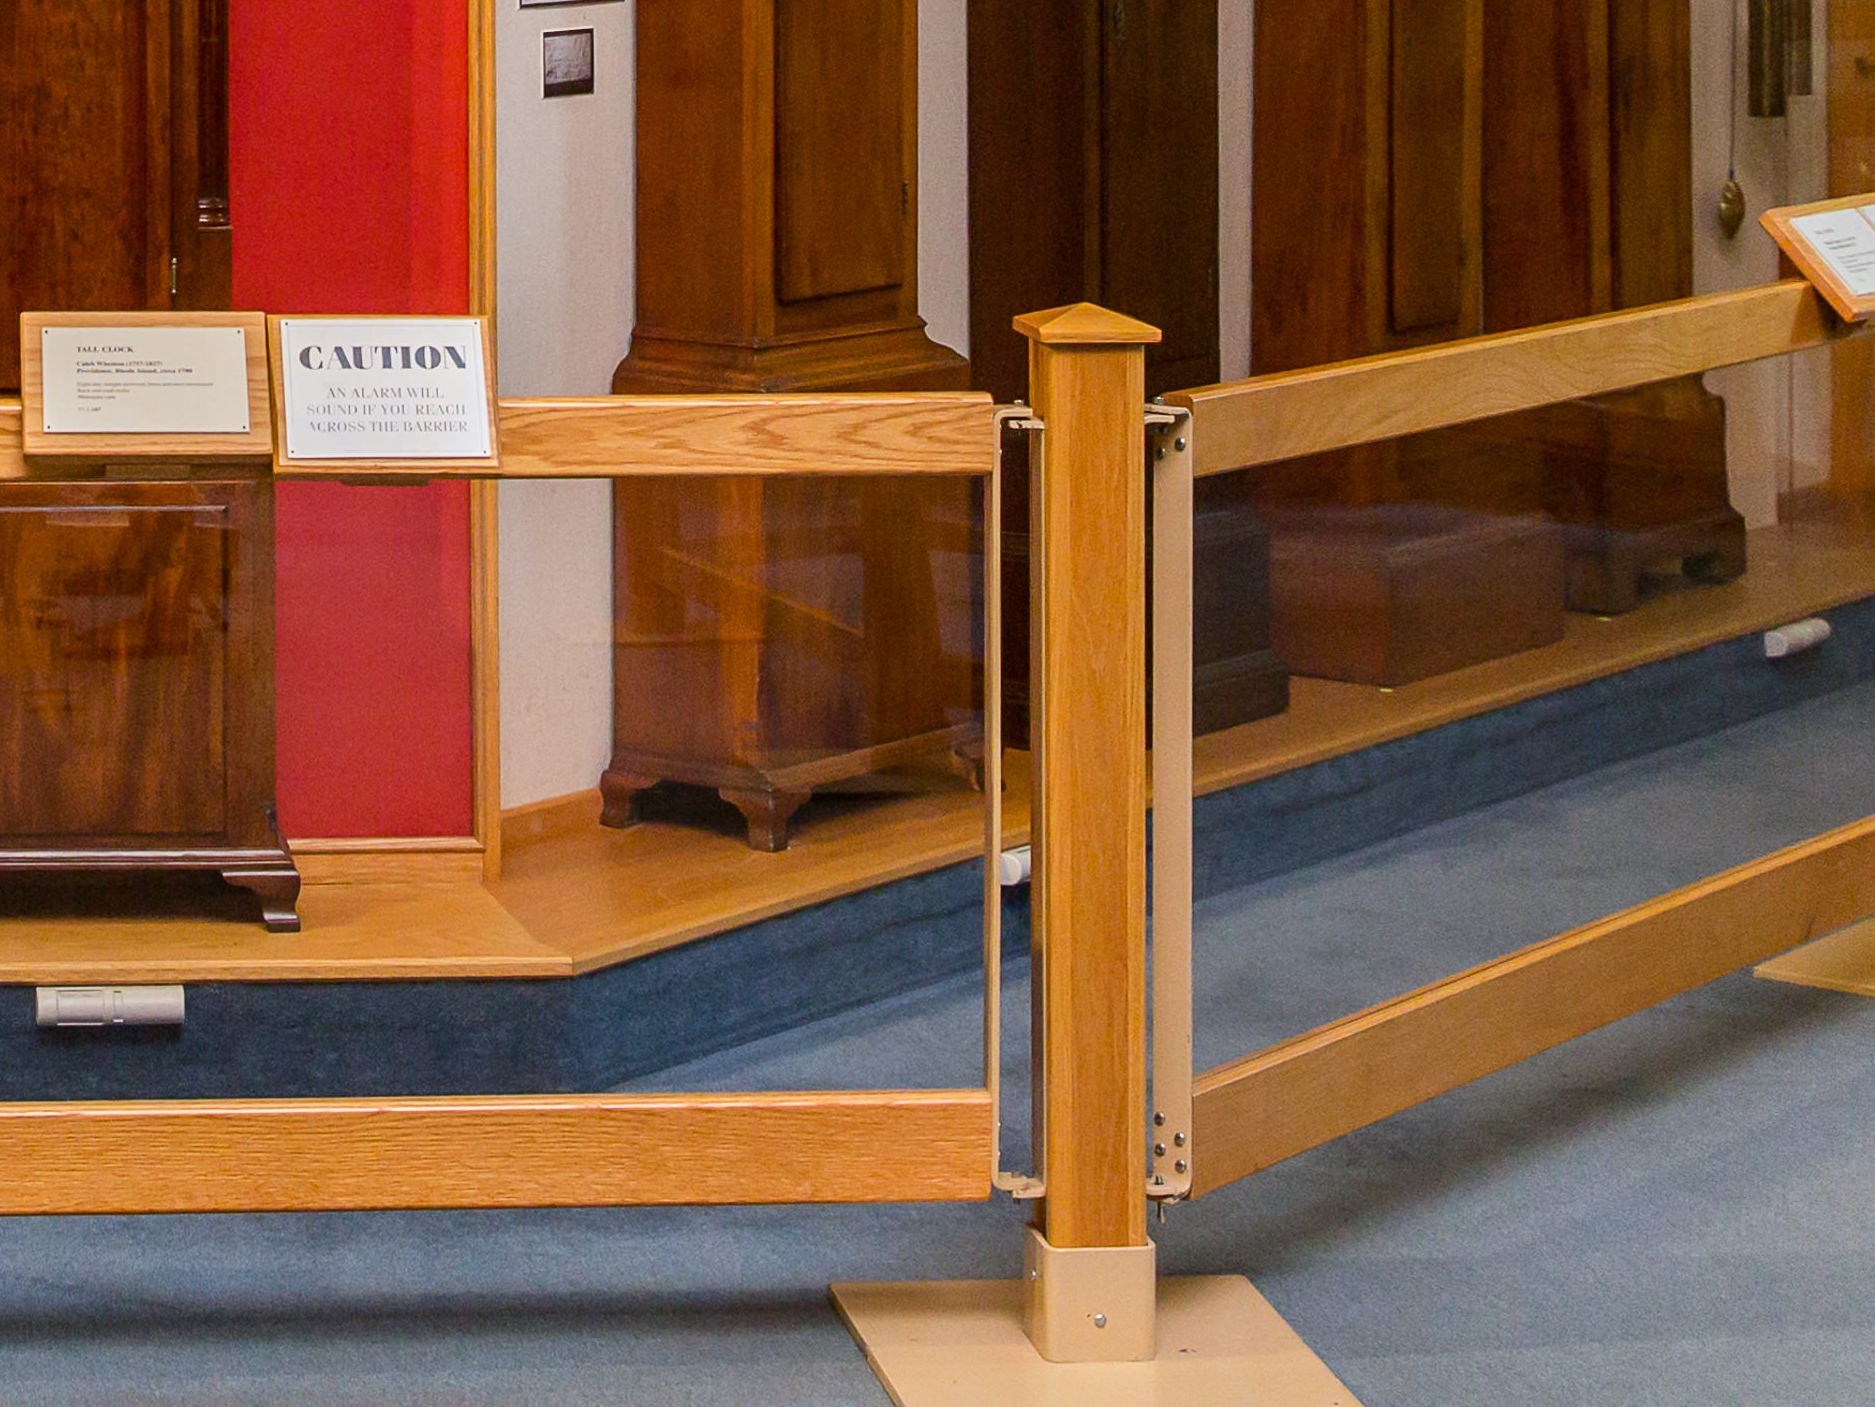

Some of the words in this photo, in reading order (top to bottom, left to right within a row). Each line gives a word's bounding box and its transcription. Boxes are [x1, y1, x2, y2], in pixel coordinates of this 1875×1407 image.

[299, 345, 467, 370] CAUTION
[326, 387, 346, 399] AN
[351, 387, 402, 399] ALARM
[406, 387, 445, 399] WILL
[307, 404, 358, 416] SOUND
[362, 404, 376, 416] IF
[380, 404, 408, 416] YOU
[415, 404, 466, 416] REACH
[309, 421, 366, 433] ACROSS
[369, 421, 399, 433] THE
[403, 421, 468, 433] BARRIER
